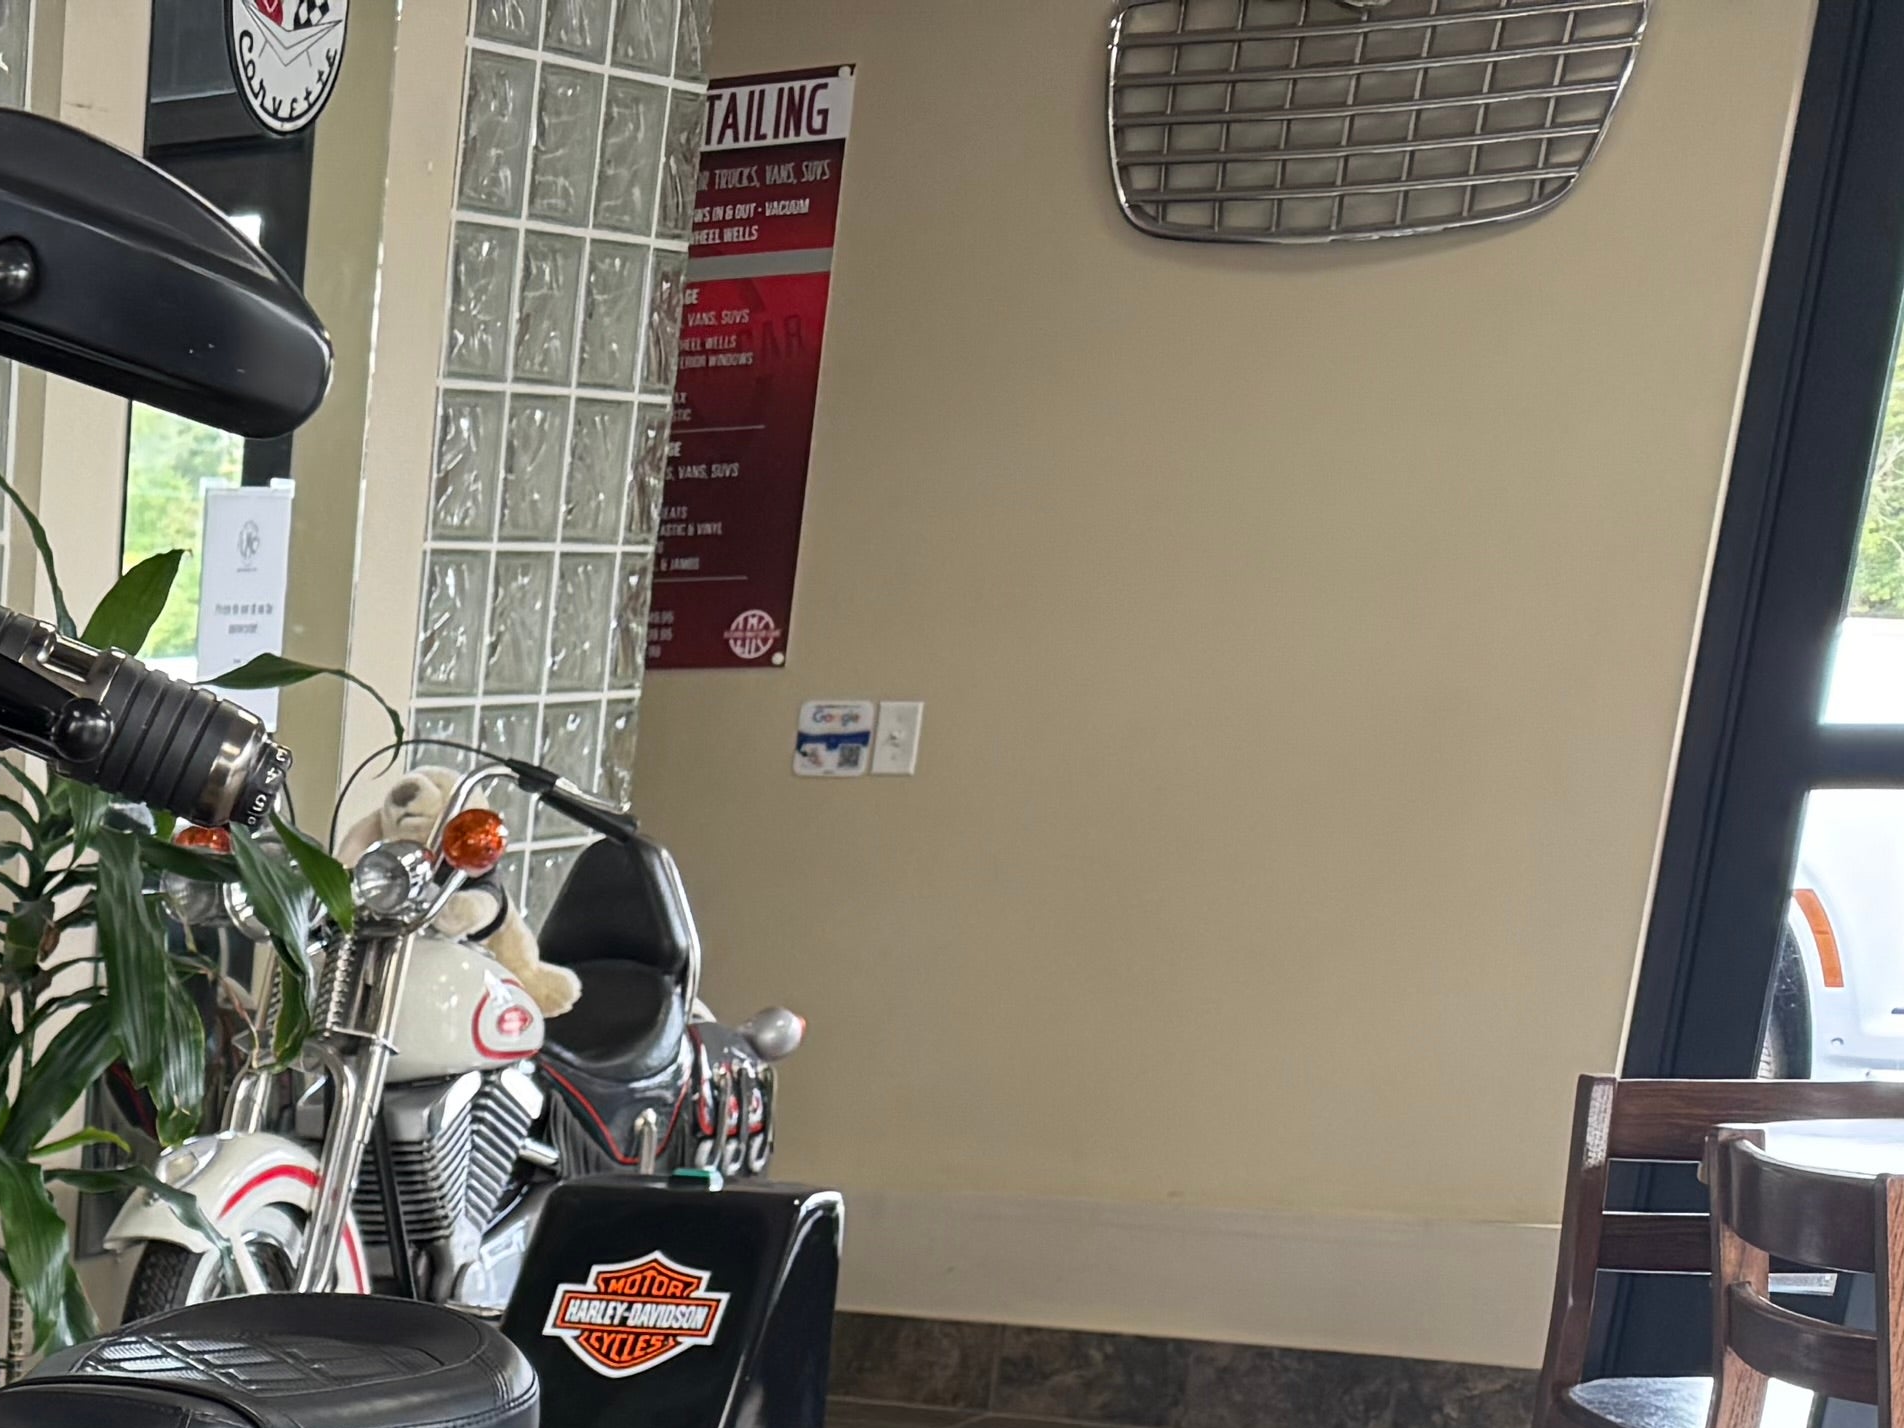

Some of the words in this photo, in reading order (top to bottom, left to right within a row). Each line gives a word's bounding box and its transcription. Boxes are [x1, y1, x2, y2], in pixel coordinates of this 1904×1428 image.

[705, 82, 830, 146] TAILING
[607, 1269, 684, 1296] MOTOR
[565, 1298, 710, 1330] HARLEY-DAVIDSON
[589, 1331, 664, 1362] CYCLES
